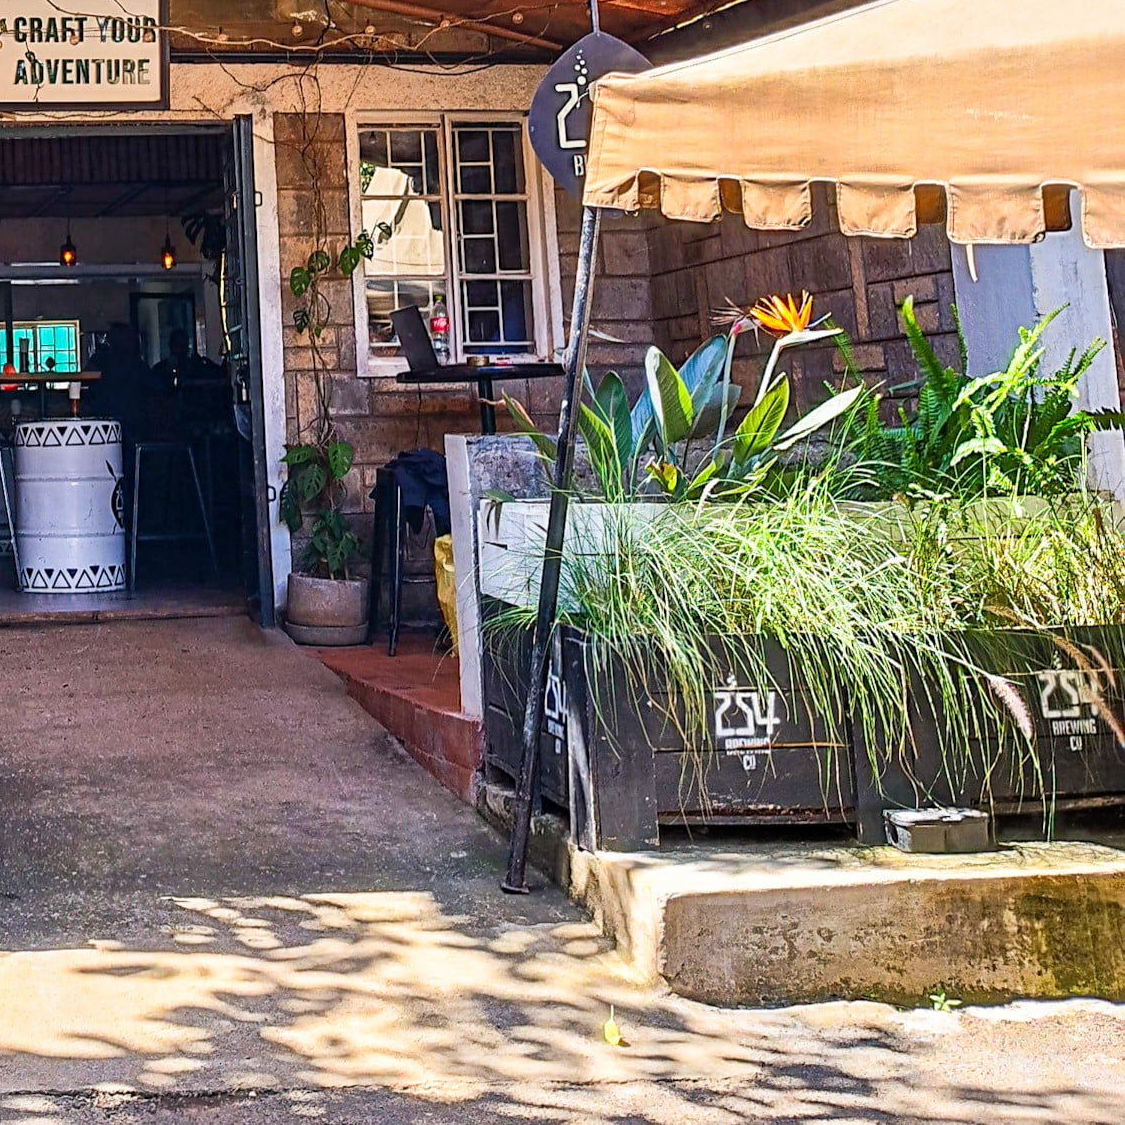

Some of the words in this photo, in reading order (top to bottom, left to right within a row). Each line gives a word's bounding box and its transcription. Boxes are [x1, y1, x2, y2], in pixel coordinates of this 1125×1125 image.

[14, 16, 87, 43] CRAFT
[95, 16, 156, 43] YOUR
[13, 59, 151, 85] ADVENTURE
[1038, 671, 1104, 718] 254
[714, 691, 781, 737] 254
[1052, 718, 1097, 735] BREWING
